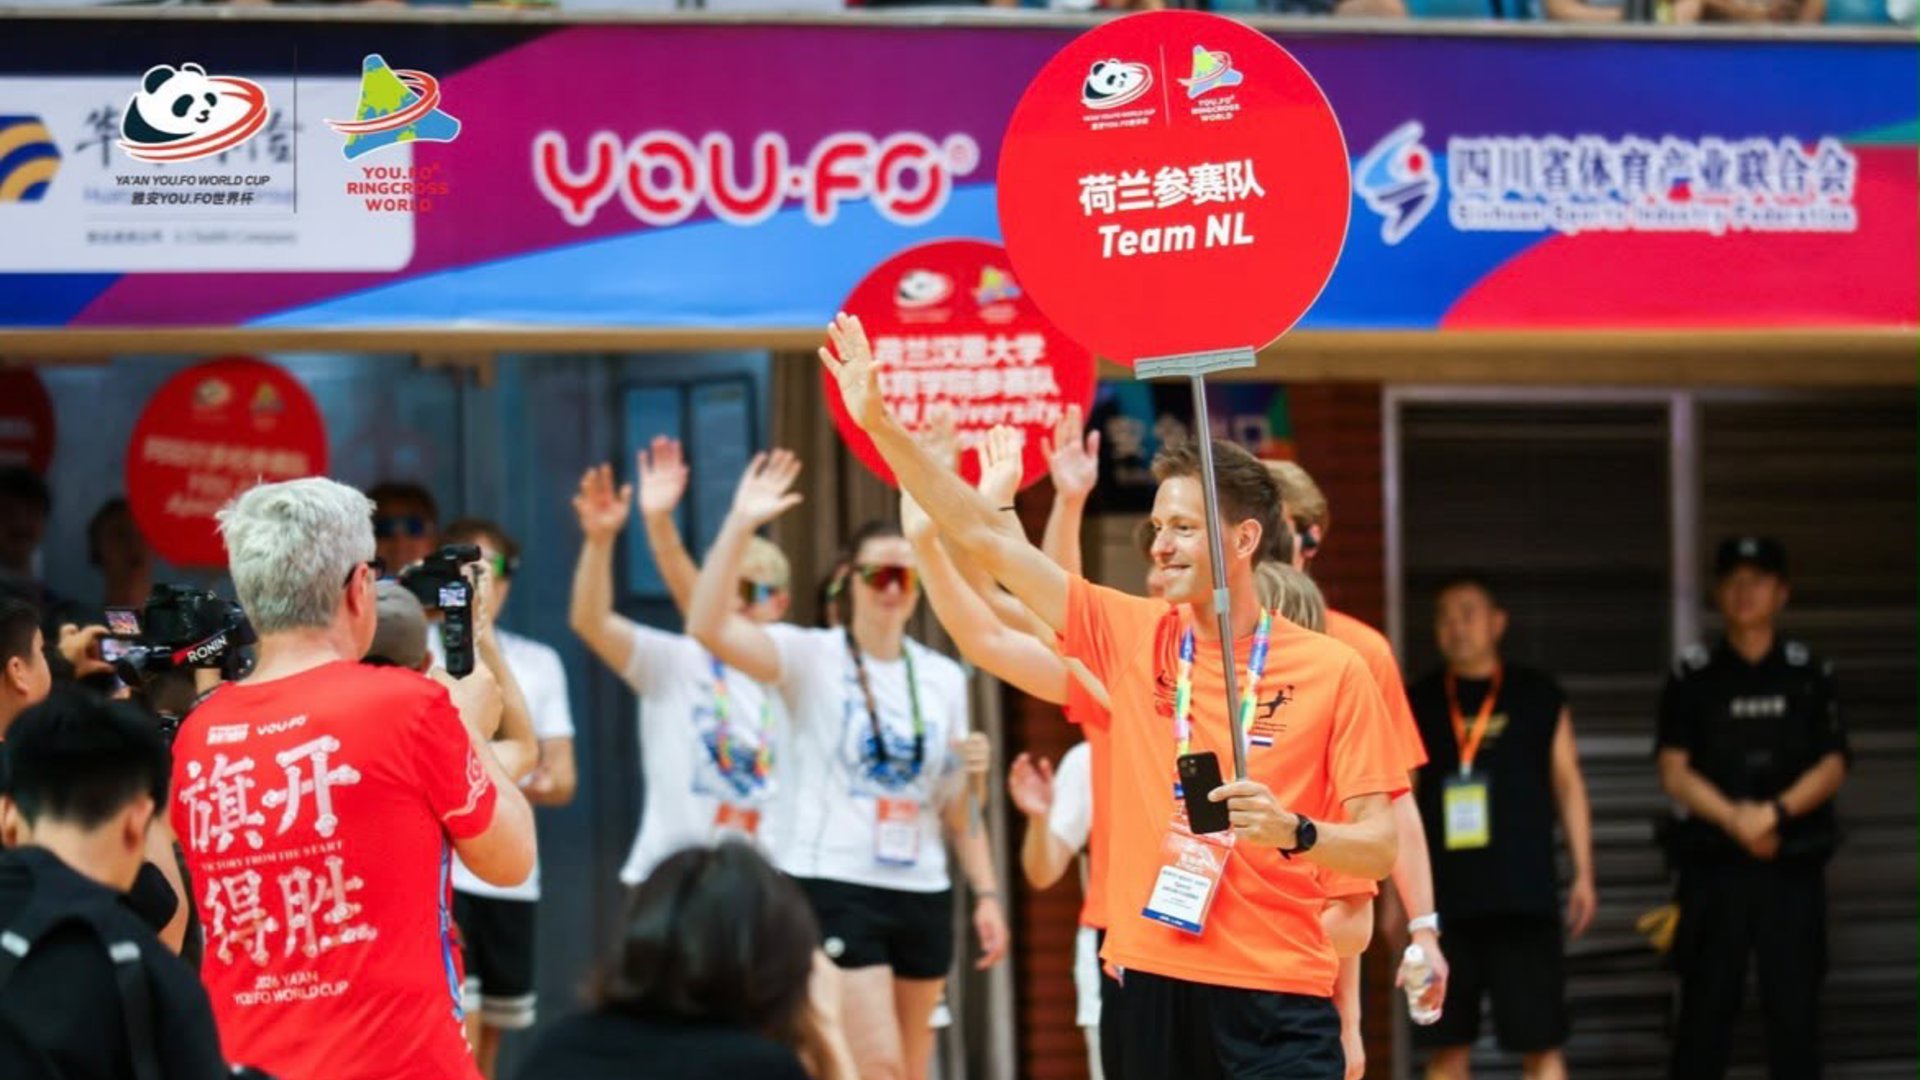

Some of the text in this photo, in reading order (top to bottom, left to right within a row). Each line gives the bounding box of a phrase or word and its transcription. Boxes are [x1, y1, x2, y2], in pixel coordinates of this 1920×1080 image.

[1078, 158, 1266, 217] 荷兰参赛队
[1450, 137, 1855, 197] 四川省体育产业联合会
[1098, 212, 1255, 259] Team NL
[187, 636, 228, 663] RONIN
[179, 735, 362, 853] 旗开
[302, 840, 344, 857] START
[203, 855, 379, 966] 得胜
[319, 979, 349, 997] CUP
